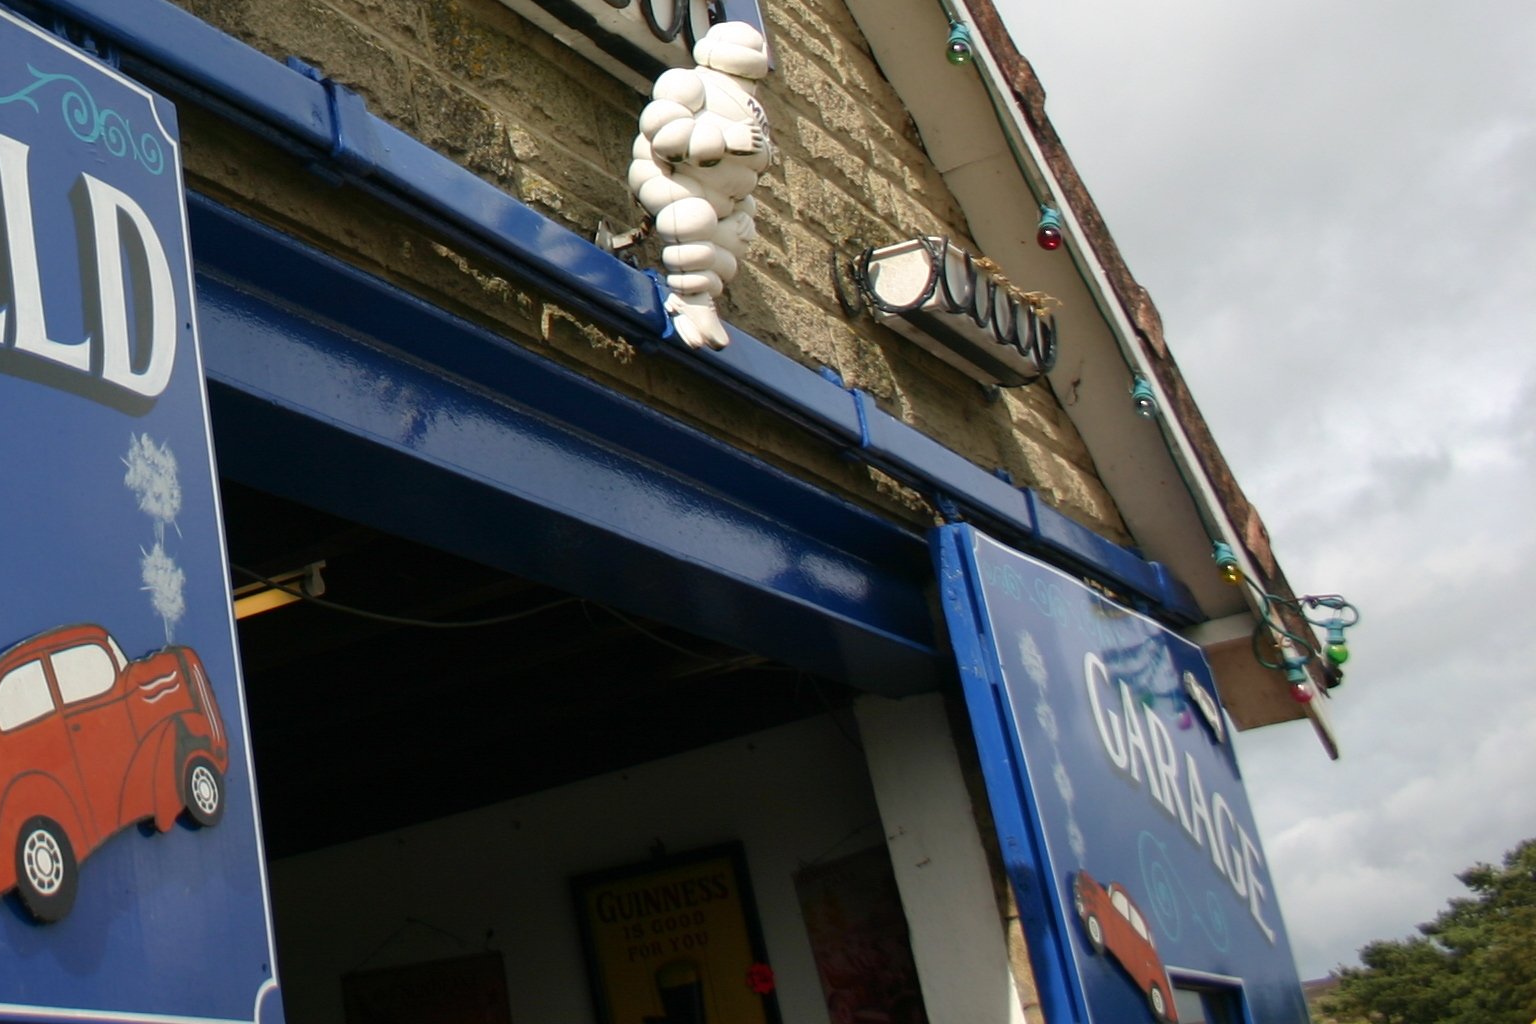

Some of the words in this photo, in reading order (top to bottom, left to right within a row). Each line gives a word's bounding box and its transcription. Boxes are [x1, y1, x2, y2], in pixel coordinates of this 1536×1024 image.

[1083, 651, 1276, 946] GARAGE
[595, 873, 730, 924] GUINNESS
[622, 923, 645, 940] IS
[651, 910, 706, 935] GOOD
[627, 939, 664, 963] FOR
[668, 931, 709, 953] YOU
